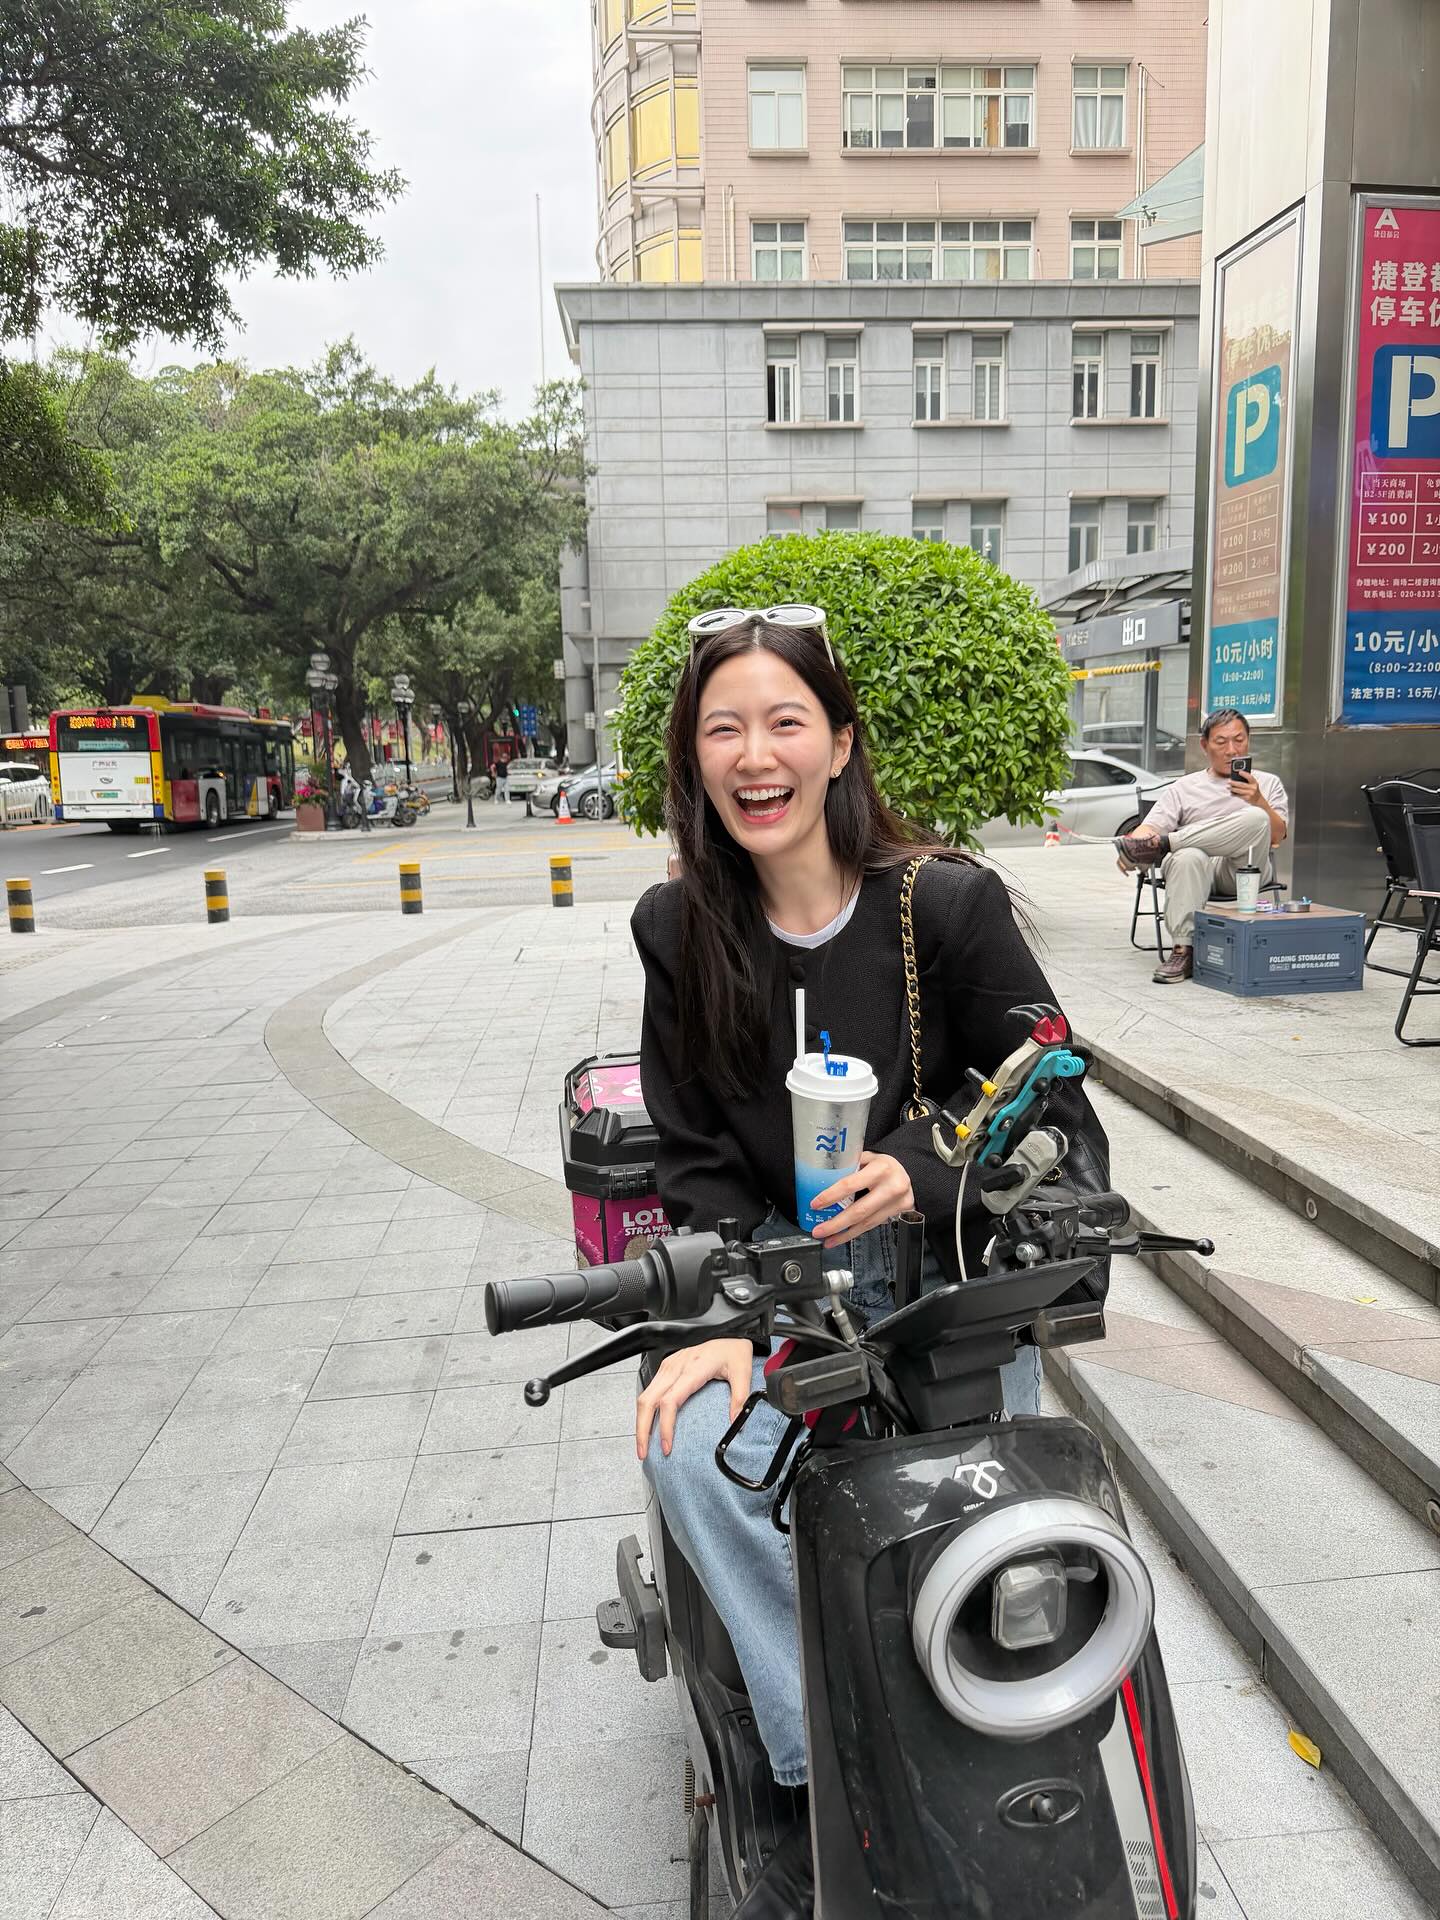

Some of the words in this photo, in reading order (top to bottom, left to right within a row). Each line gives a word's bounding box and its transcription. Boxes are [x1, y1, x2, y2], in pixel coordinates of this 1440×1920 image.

[1374, 207, 1400, 229] A
[1388, 355, 1440, 448] P
[1234, 383, 1270, 477] P
[1373, 478, 1407, 488] 当天商场
[1368, 512, 1408, 525] ¥100
[1366, 542, 1406, 555] ¥200
[1122, 617, 1146, 646] 出口
[1215, 636, 1274, 664] 10元/小时
[1351, 687, 1440, 699] 法定节日：16元/
[1269, 955, 1297, 963] FOLDING
[1298, 953, 1326, 962] STORAGE
